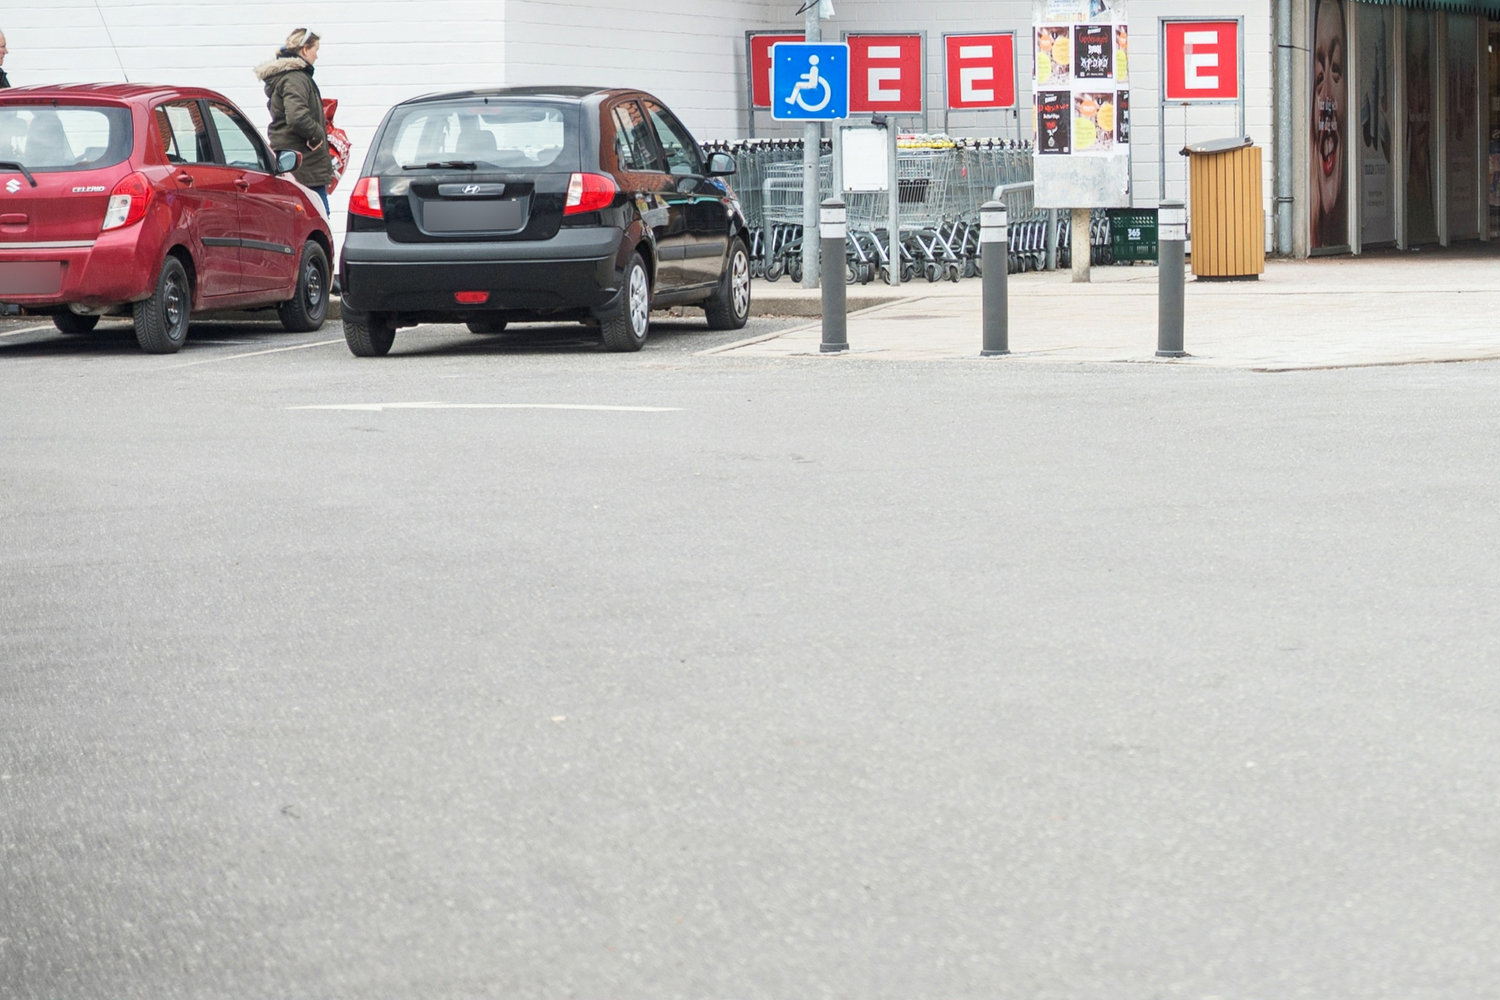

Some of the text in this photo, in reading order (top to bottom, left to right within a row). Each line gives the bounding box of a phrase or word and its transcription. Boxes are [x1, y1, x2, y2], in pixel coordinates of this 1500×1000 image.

[868, 46, 900, 101] E
[959, 45, 994, 102] E
[1184, 30, 1219, 89] E
[1127, 228, 1141, 237] 365
